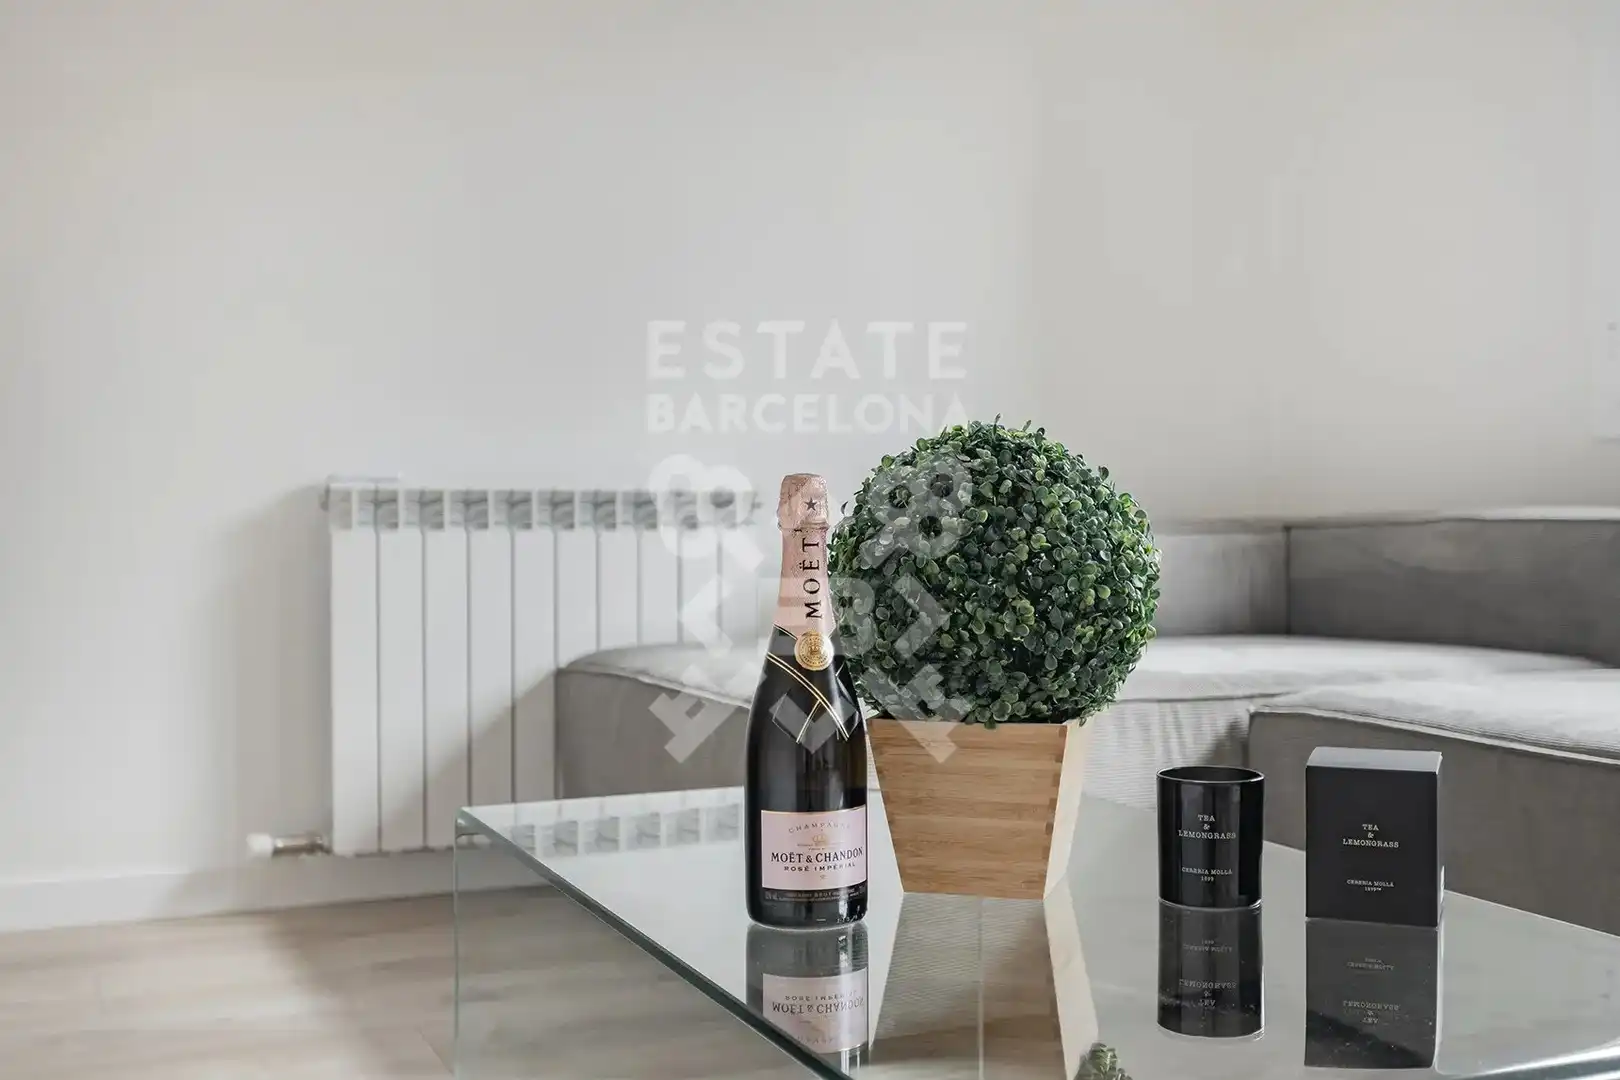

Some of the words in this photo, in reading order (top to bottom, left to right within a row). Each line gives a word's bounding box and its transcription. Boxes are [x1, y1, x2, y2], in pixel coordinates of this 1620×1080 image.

[800, 538, 822, 619] MOËT
[1197, 814, 1216, 822] TEA
[1362, 823, 1379, 831] TEA
[1178, 829, 1237, 839] LEMONGRASS
[1342, 838, 1399, 848] LEMONGRASS
[771, 852, 804, 863] MOËT
[805, 854, 813, 863] &
[815, 846, 864, 863] CHANDON
[814, 862, 856, 871] IMPÉRIAL
